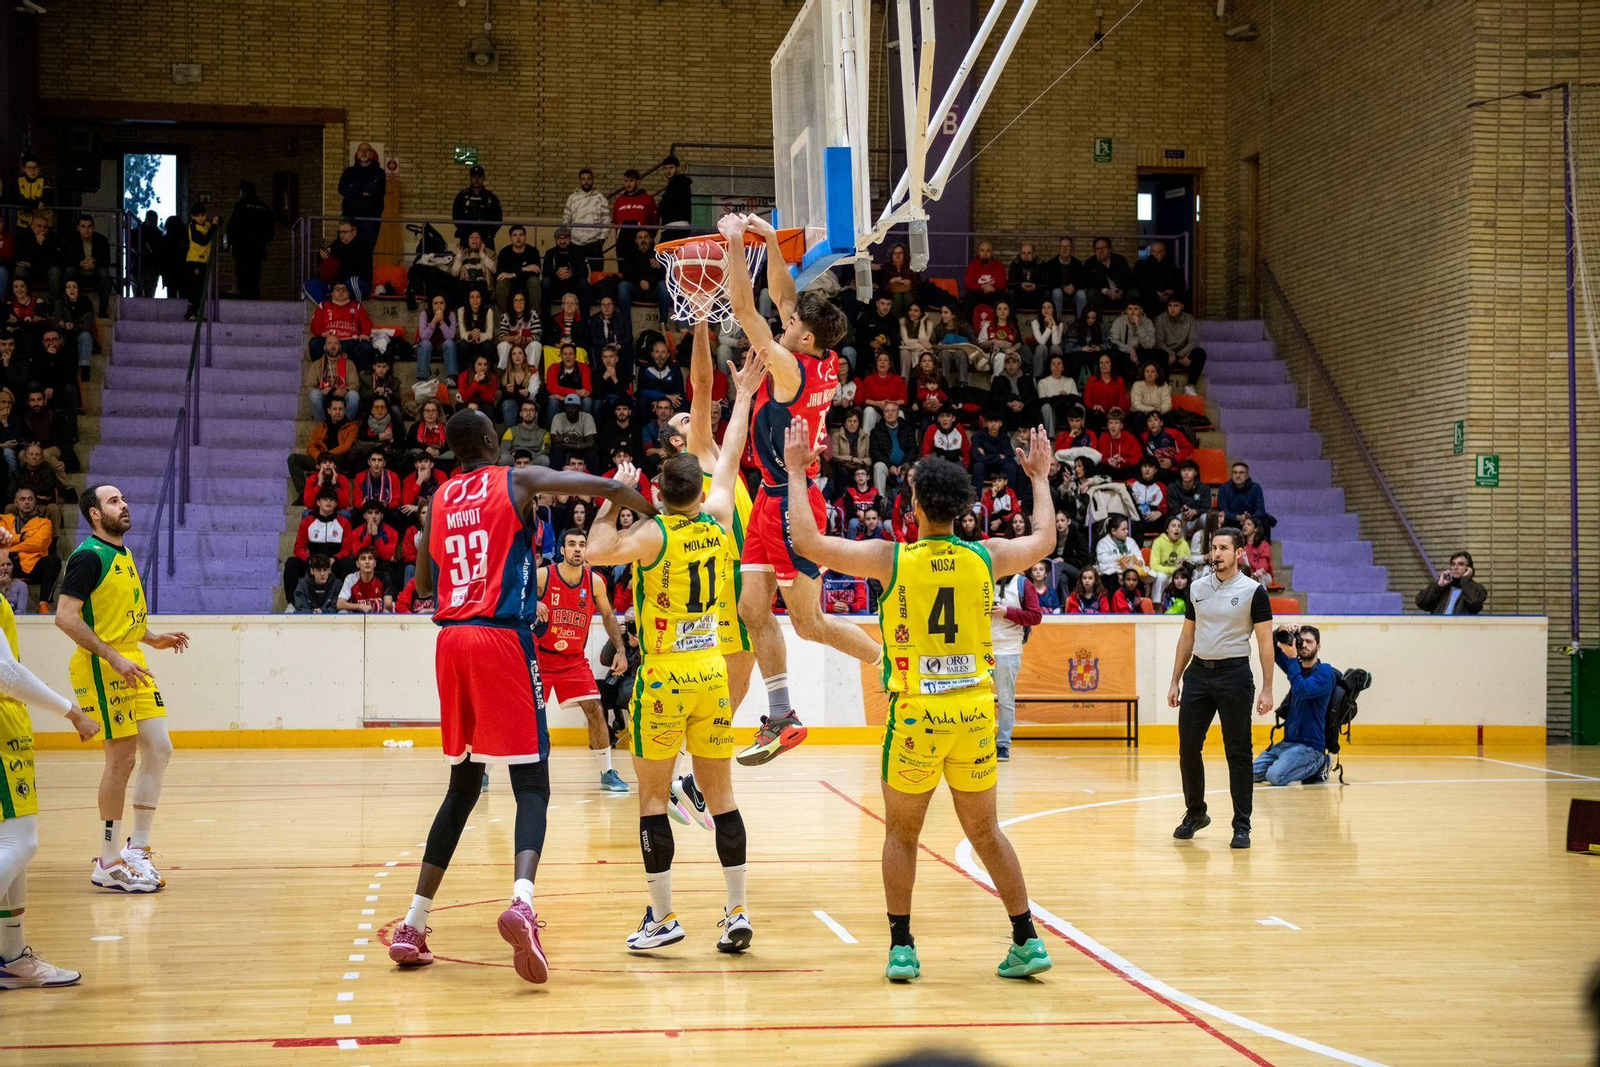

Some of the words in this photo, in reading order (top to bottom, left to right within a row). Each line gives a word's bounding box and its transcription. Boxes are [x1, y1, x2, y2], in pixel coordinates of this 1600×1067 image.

[943, 111, 958, 135] B
[446, 508, 481, 530] MAYOT
[444, 530, 489, 586] 33
[931, 559, 956, 572] NOSA
[662, 560, 671, 589] RUSTER
[685, 556, 718, 613] 11
[551, 593, 560, 606] 13
[898, 584, 908, 619] RUSTER
[928, 587, 958, 644] 4
[946, 655, 969, 667] ORO
[641, 829, 651, 852] Joma
